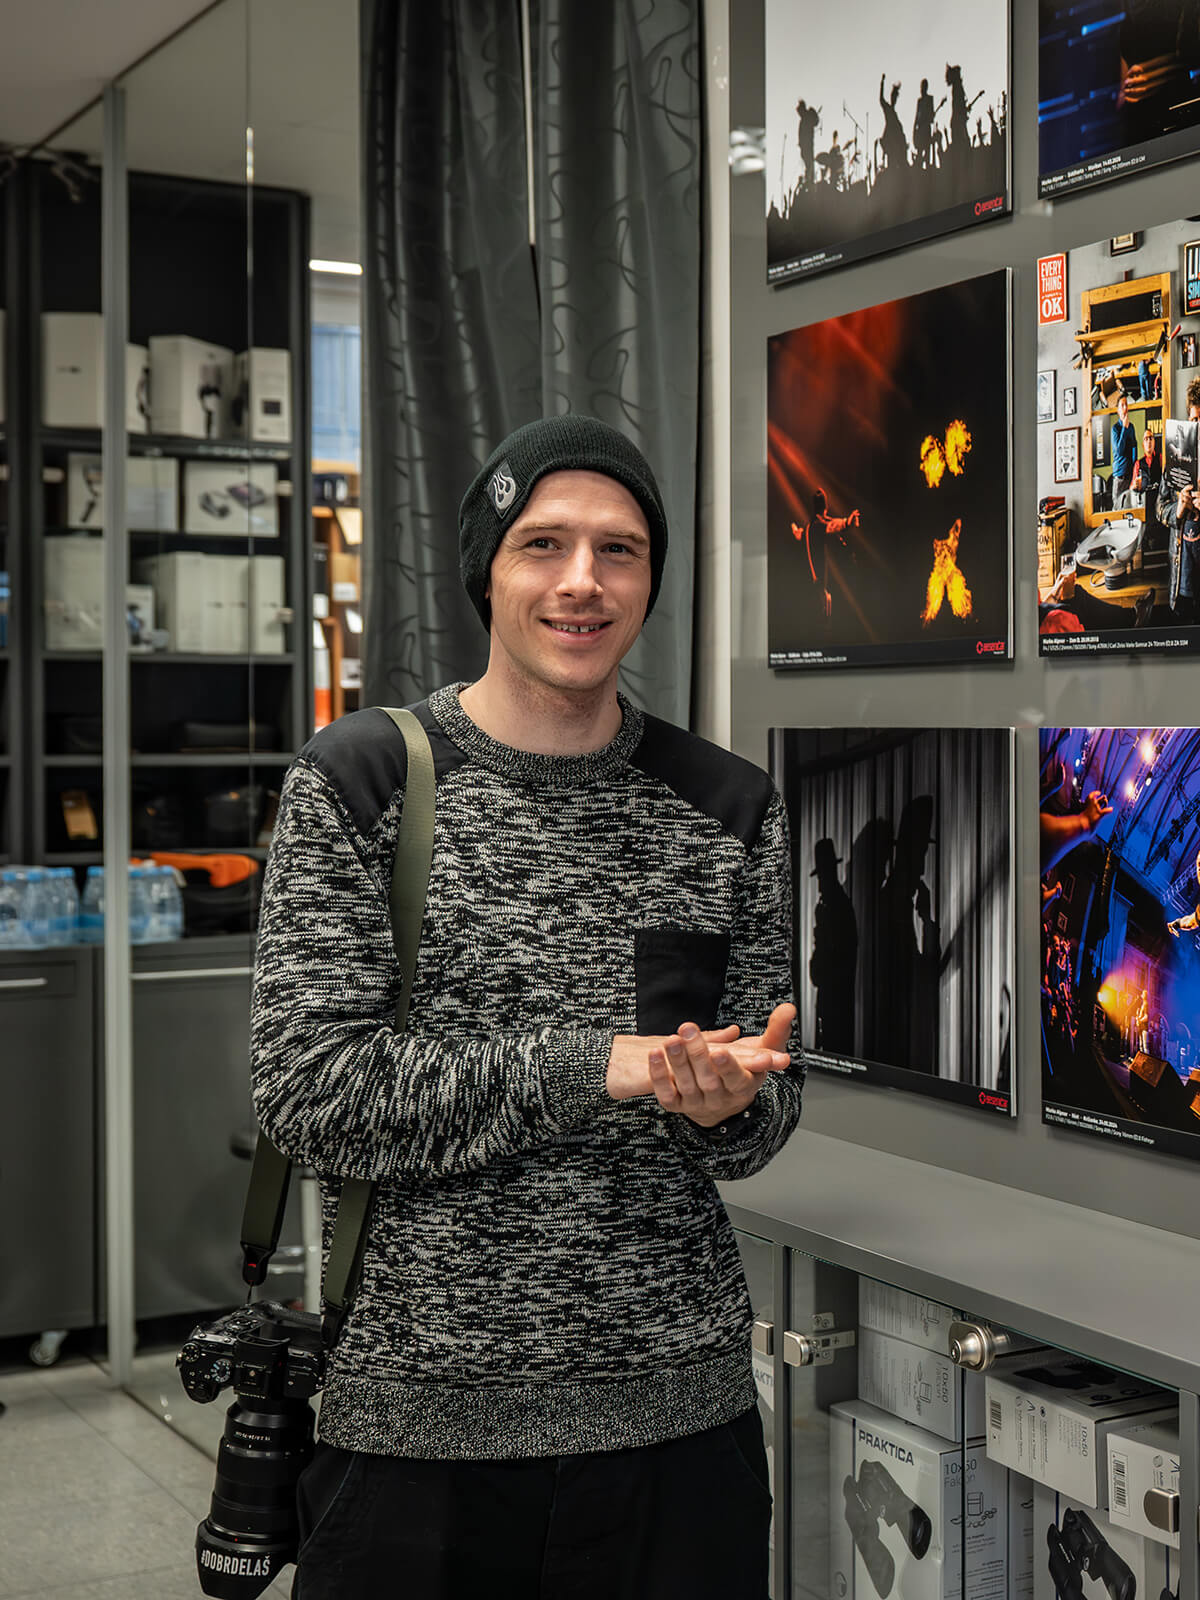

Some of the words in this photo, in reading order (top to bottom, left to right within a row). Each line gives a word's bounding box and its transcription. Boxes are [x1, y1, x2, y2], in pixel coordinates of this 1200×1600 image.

[1041, 259, 1062, 278] EVERY
[1041, 275, 1062, 293] THING
[1042, 296, 1063, 318] OK
[858, 1428, 915, 1466] PRAKTICA
[201, 1549, 271, 1577] #DOBRDELAŠ
